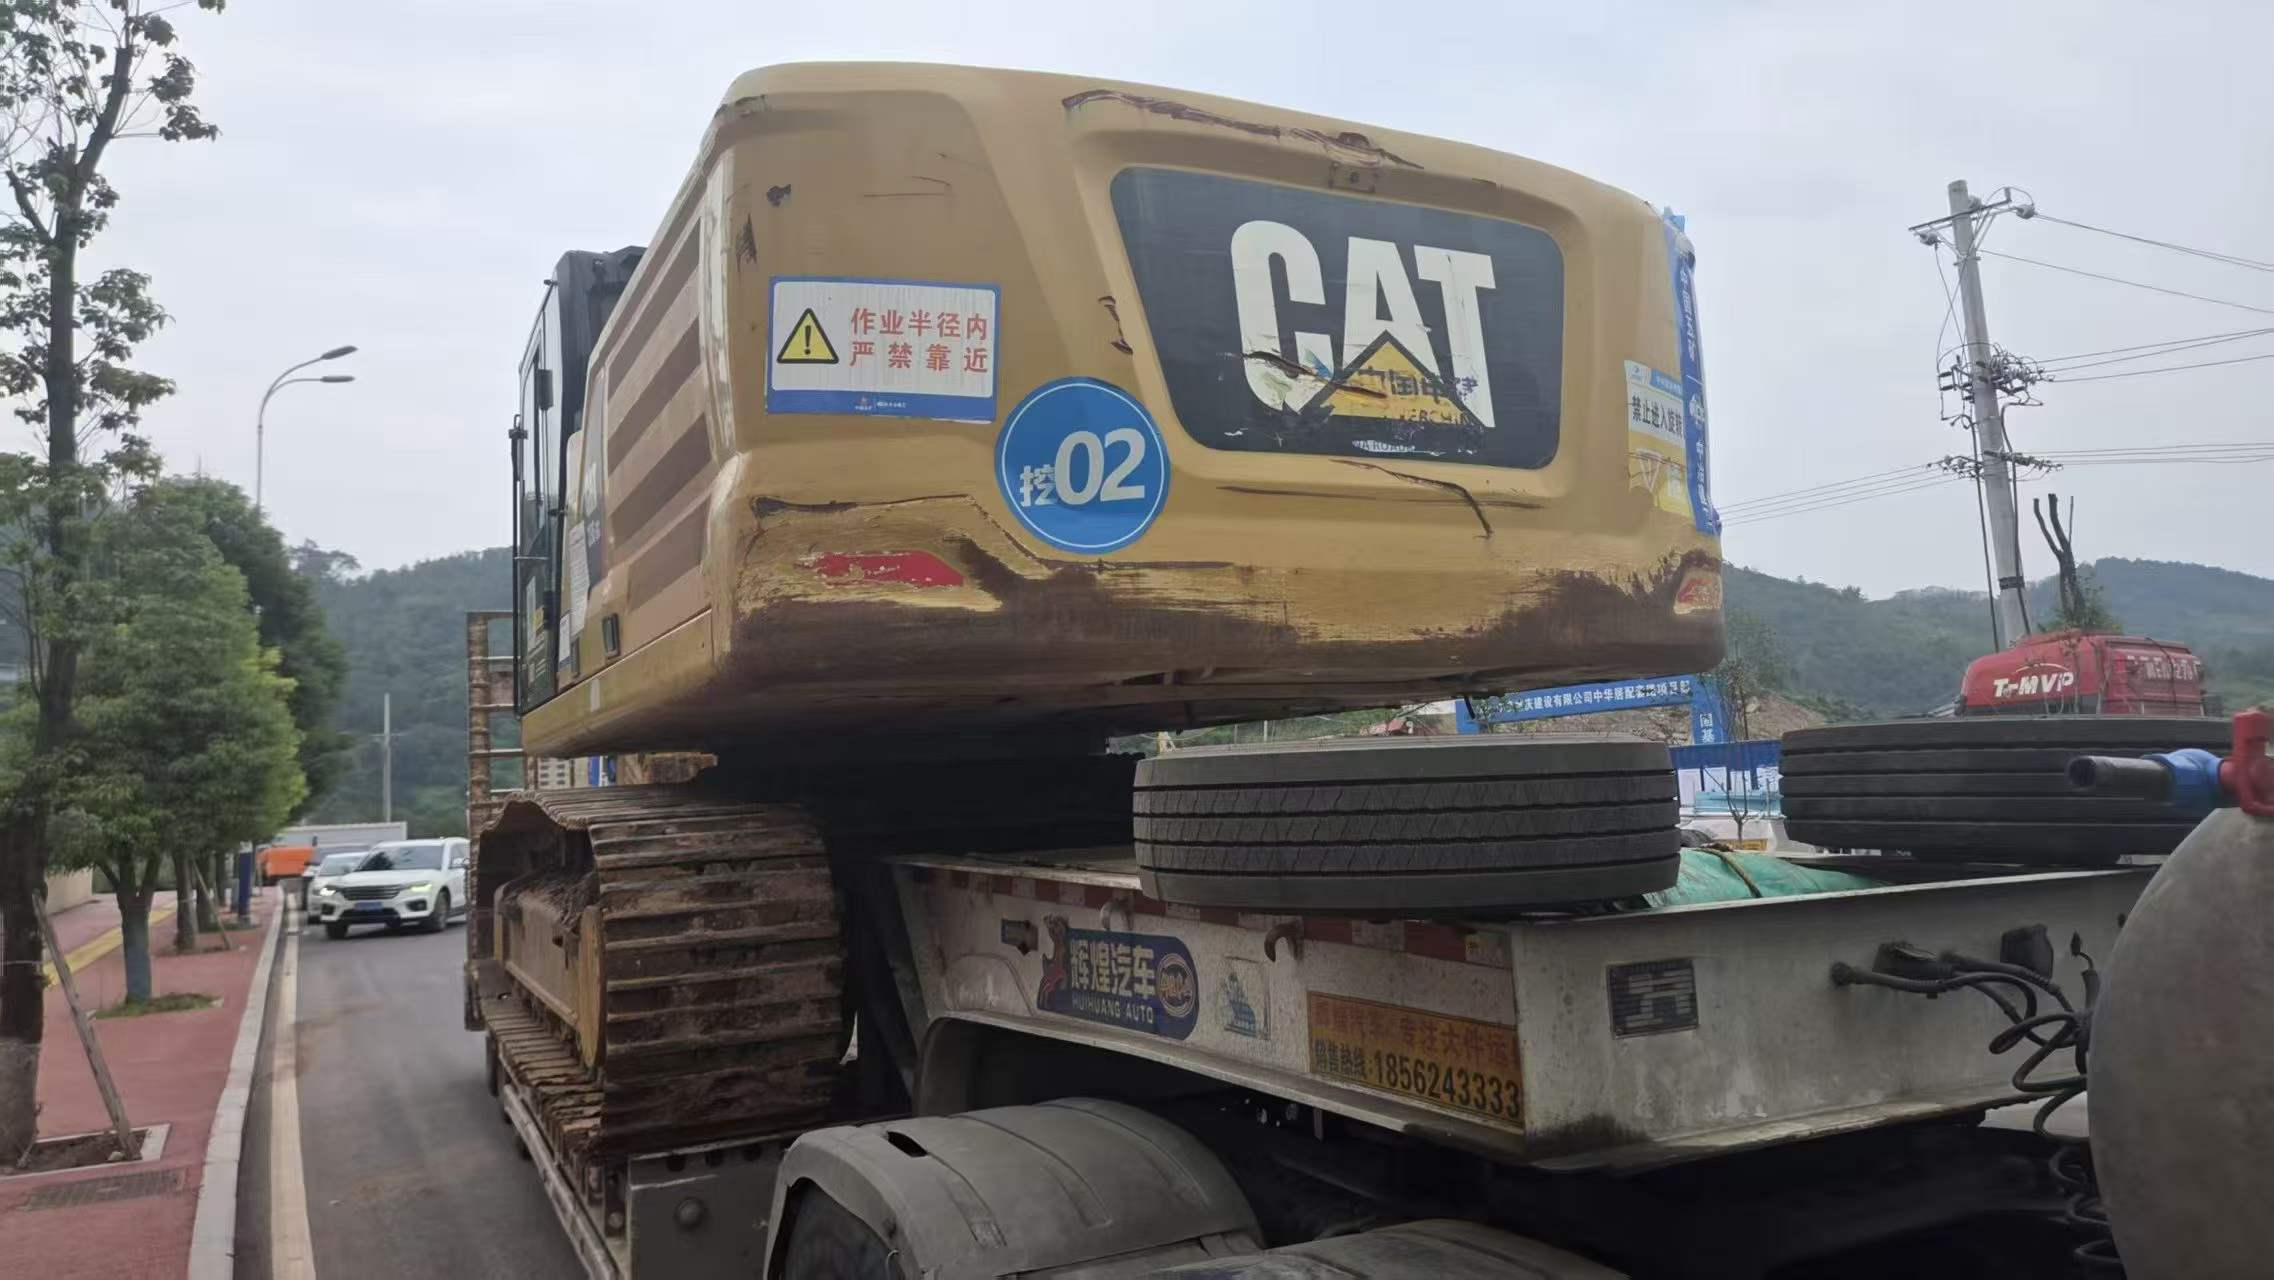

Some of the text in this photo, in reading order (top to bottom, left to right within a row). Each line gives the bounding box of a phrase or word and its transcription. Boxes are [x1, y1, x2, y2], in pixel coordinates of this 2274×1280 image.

[851, 307, 988, 341] 作业半径内
[1231, 220, 1496, 428] CAT
[849, 340, 988, 374] 严禁靠近
[1070, 938, 1156, 1000] 辉煌汽车
[1071, 993, 1154, 1024] HUIHUANG AUTO
